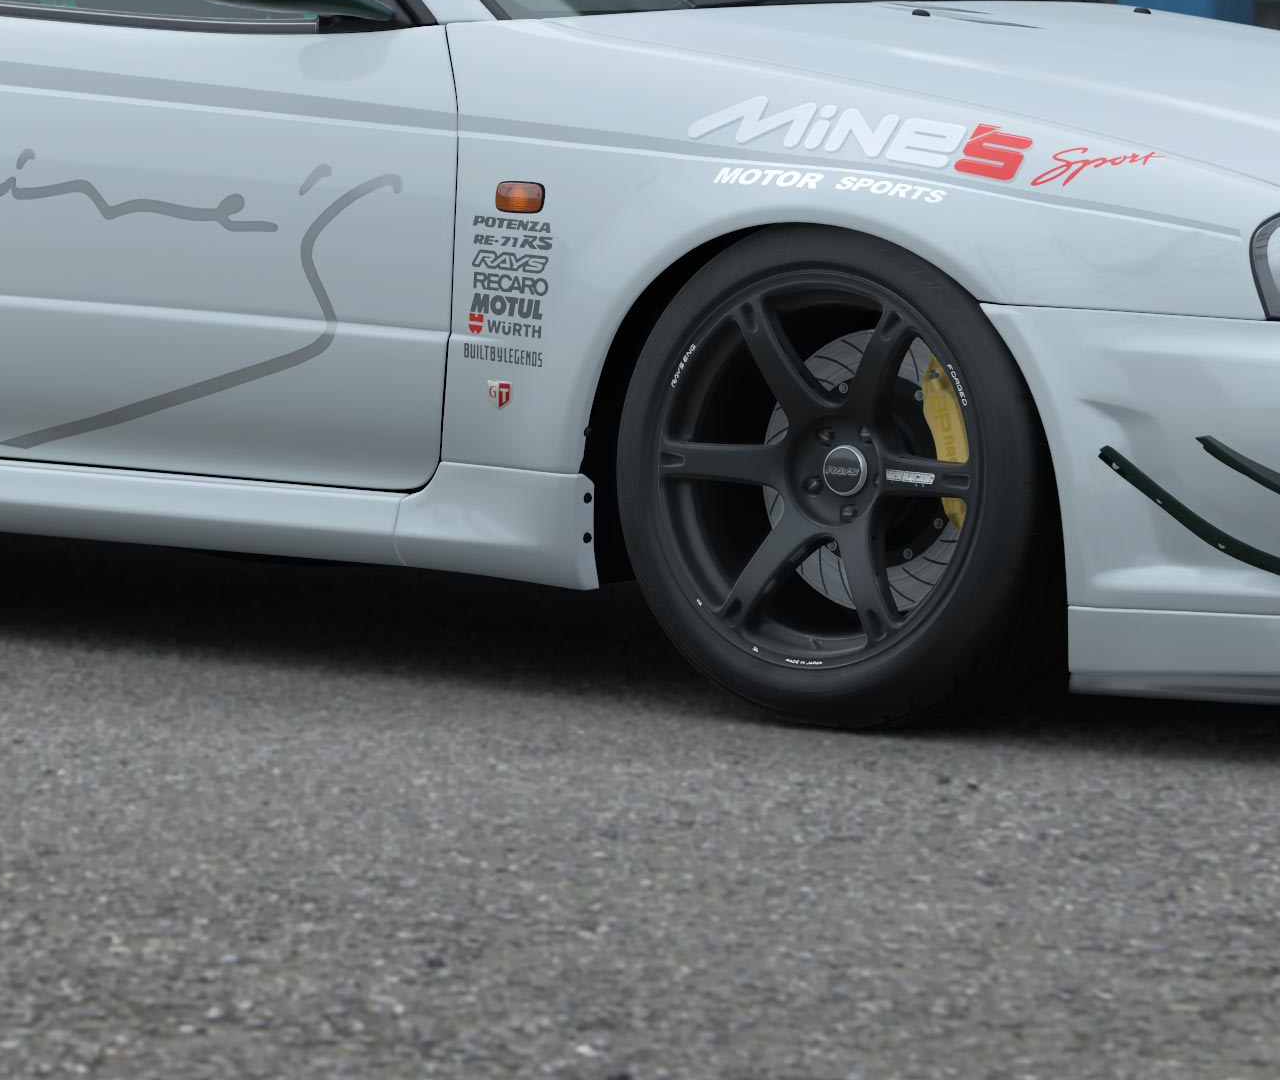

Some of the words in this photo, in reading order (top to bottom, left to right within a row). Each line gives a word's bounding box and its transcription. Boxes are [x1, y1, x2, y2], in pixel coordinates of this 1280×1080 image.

[712, 166, 824, 190] MOTOR
[835, 175, 947, 204] SPORTS
[472, 215, 551, 234] POTENZA
[472, 249, 549, 274] RAYS
[473, 272, 549, 296] RECARO
[470, 293, 543, 320] MOTUL
[463, 342, 543, 368] BUILTBYLEGENDS
[946, 364, 968, 407] FORGED
[825, 465, 860, 476] RAYS
